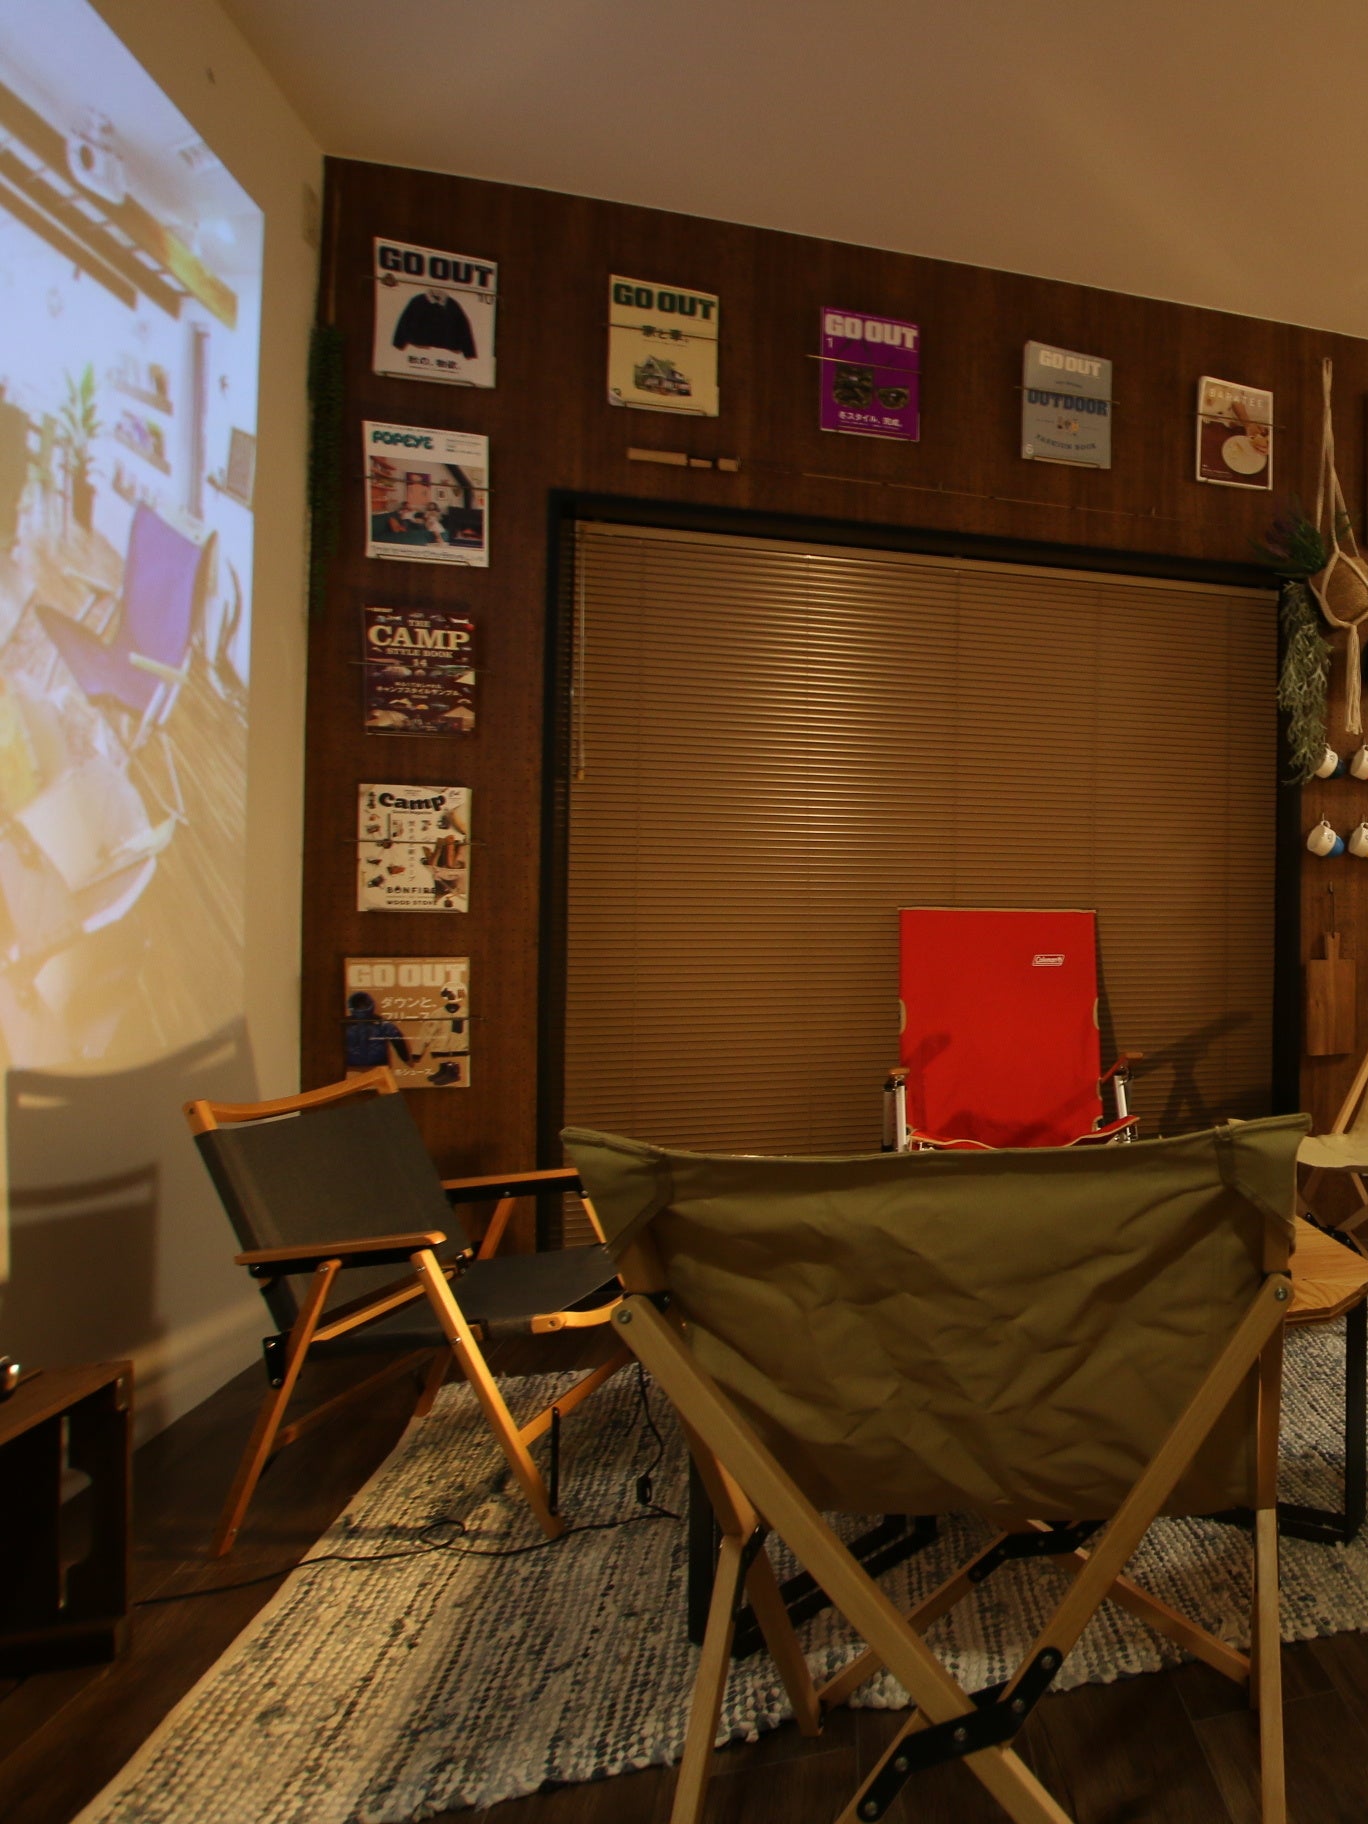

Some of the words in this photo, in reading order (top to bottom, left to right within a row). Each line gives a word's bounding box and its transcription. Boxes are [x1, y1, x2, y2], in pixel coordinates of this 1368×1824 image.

[379, 245, 424, 276] GO
[429, 256, 494, 287] OUT
[613, 283, 653, 310] GO
[657, 291, 715, 320] OUT
[825, 313, 863, 340] GO
[865, 320, 918, 349] OUT
[1040, 350, 1065, 370] GO
[1066, 356, 1101, 377] OUT
[1027, 389, 1108, 417] OUTDOOR
[372, 430, 434, 450] POPEYE
[367, 624, 471, 651] CAMP
[423, 649, 454, 658] BOOK
[378, 792, 446, 811] Camp
[387, 886, 437, 894] BONFIRE
[349, 964, 396, 987] GO
[398, 963, 467, 987] OUT
